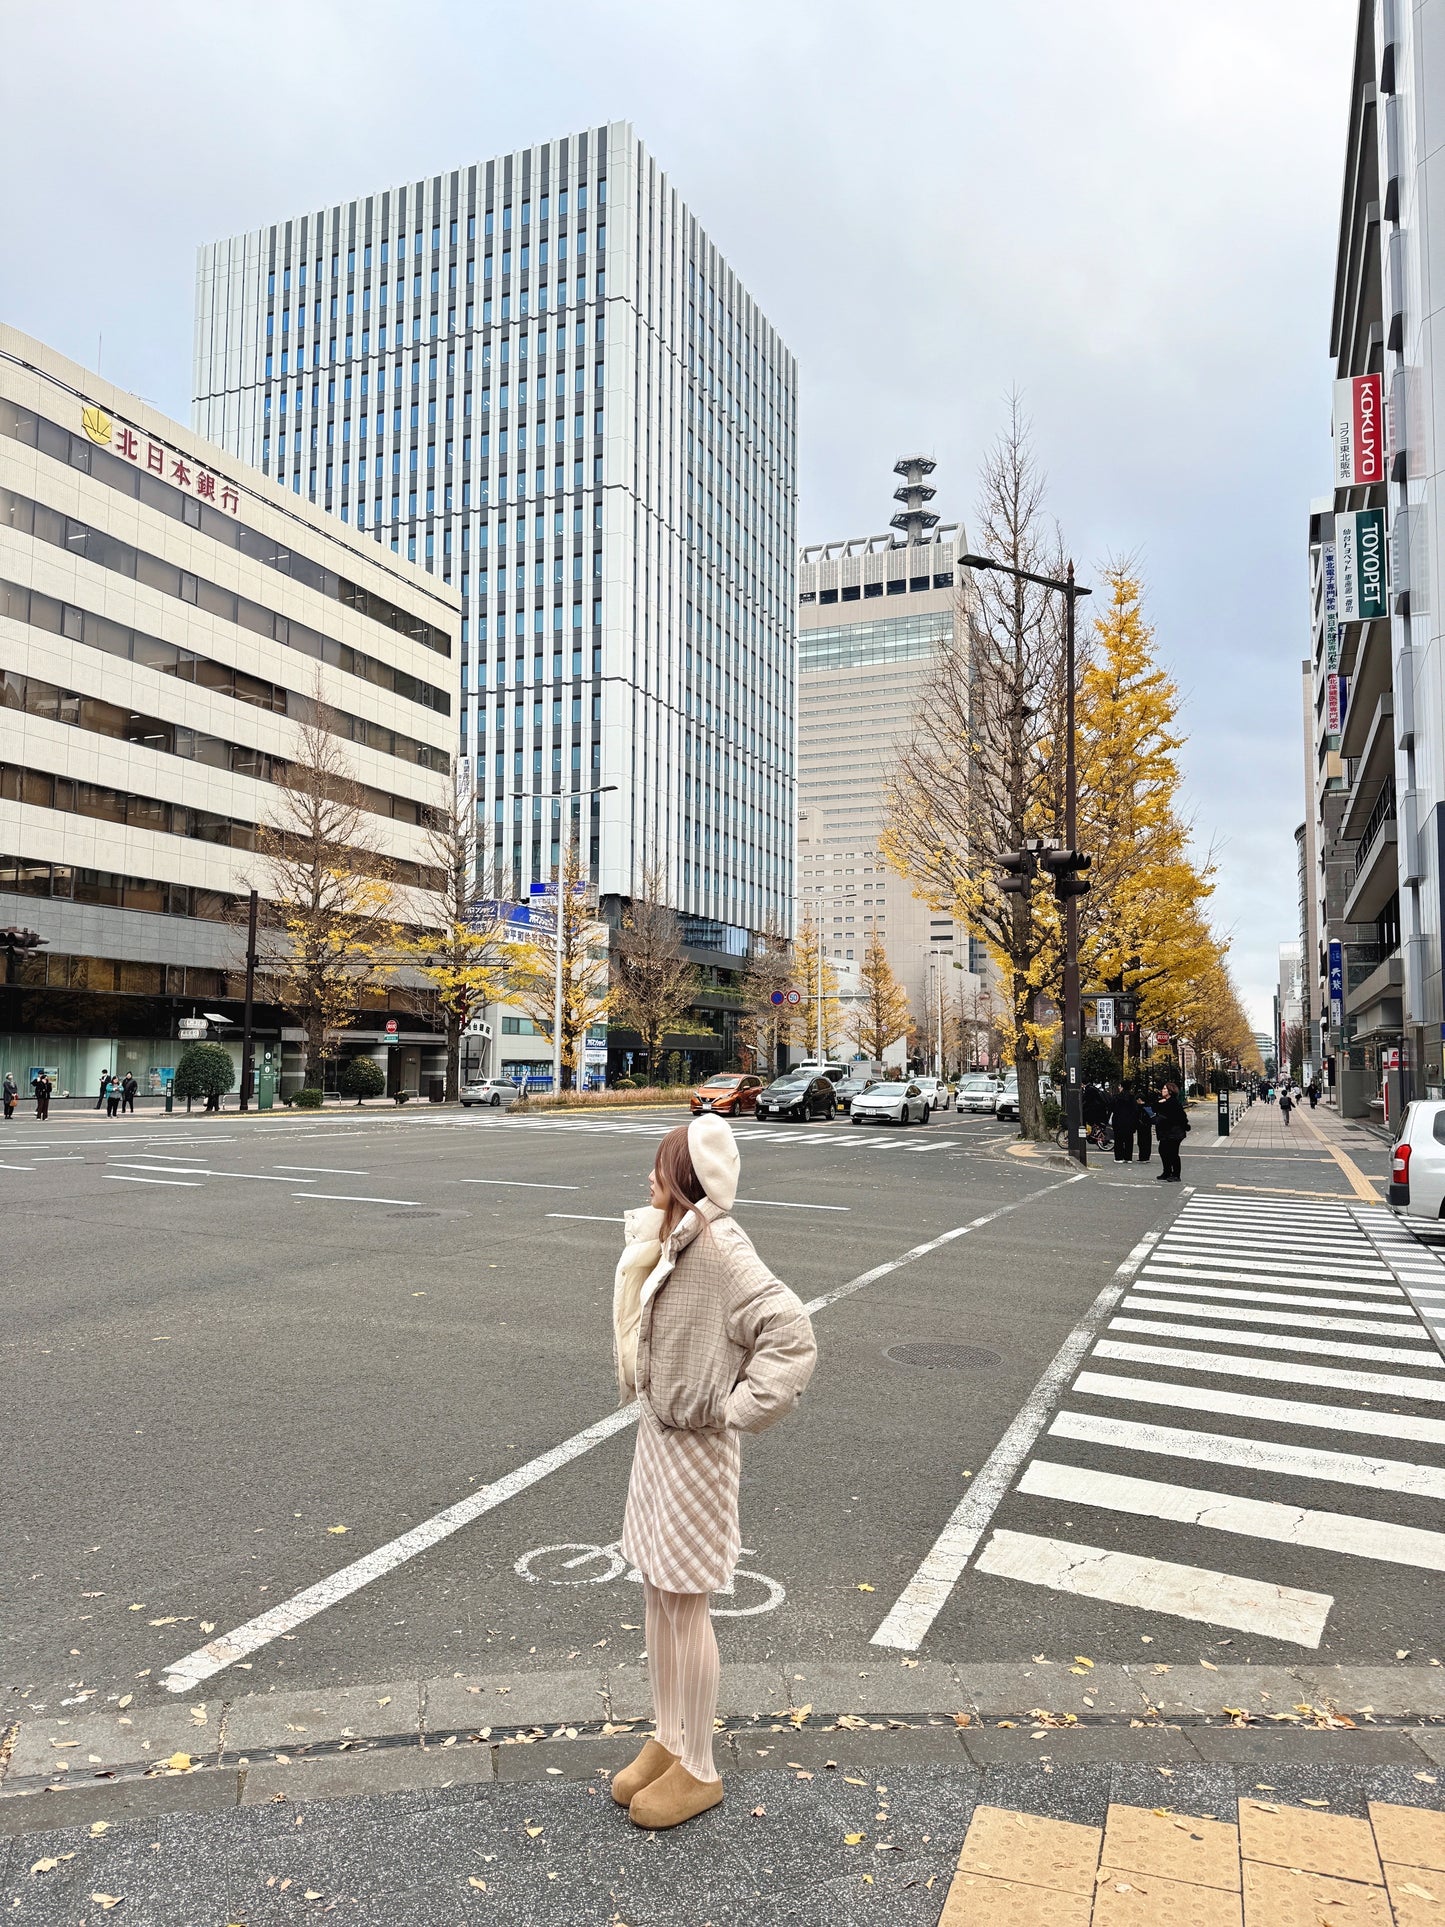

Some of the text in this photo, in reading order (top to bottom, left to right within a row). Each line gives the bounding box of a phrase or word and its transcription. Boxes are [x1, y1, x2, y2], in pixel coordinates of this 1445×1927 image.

[1339, 421, 1351, 479] コクヨ東北販売
[1360, 382, 1375, 476] KOKUYO
[116, 427, 240, 515] 北日本銀行
[1342, 528, 1353, 572] 仙台トヨペット
[1361, 522, 1381, 605] TOYOPET
[1325, 554, 1336, 611] 東北電子専門学校
[1327, 613, 1337, 670] 東日本航空専門学校
